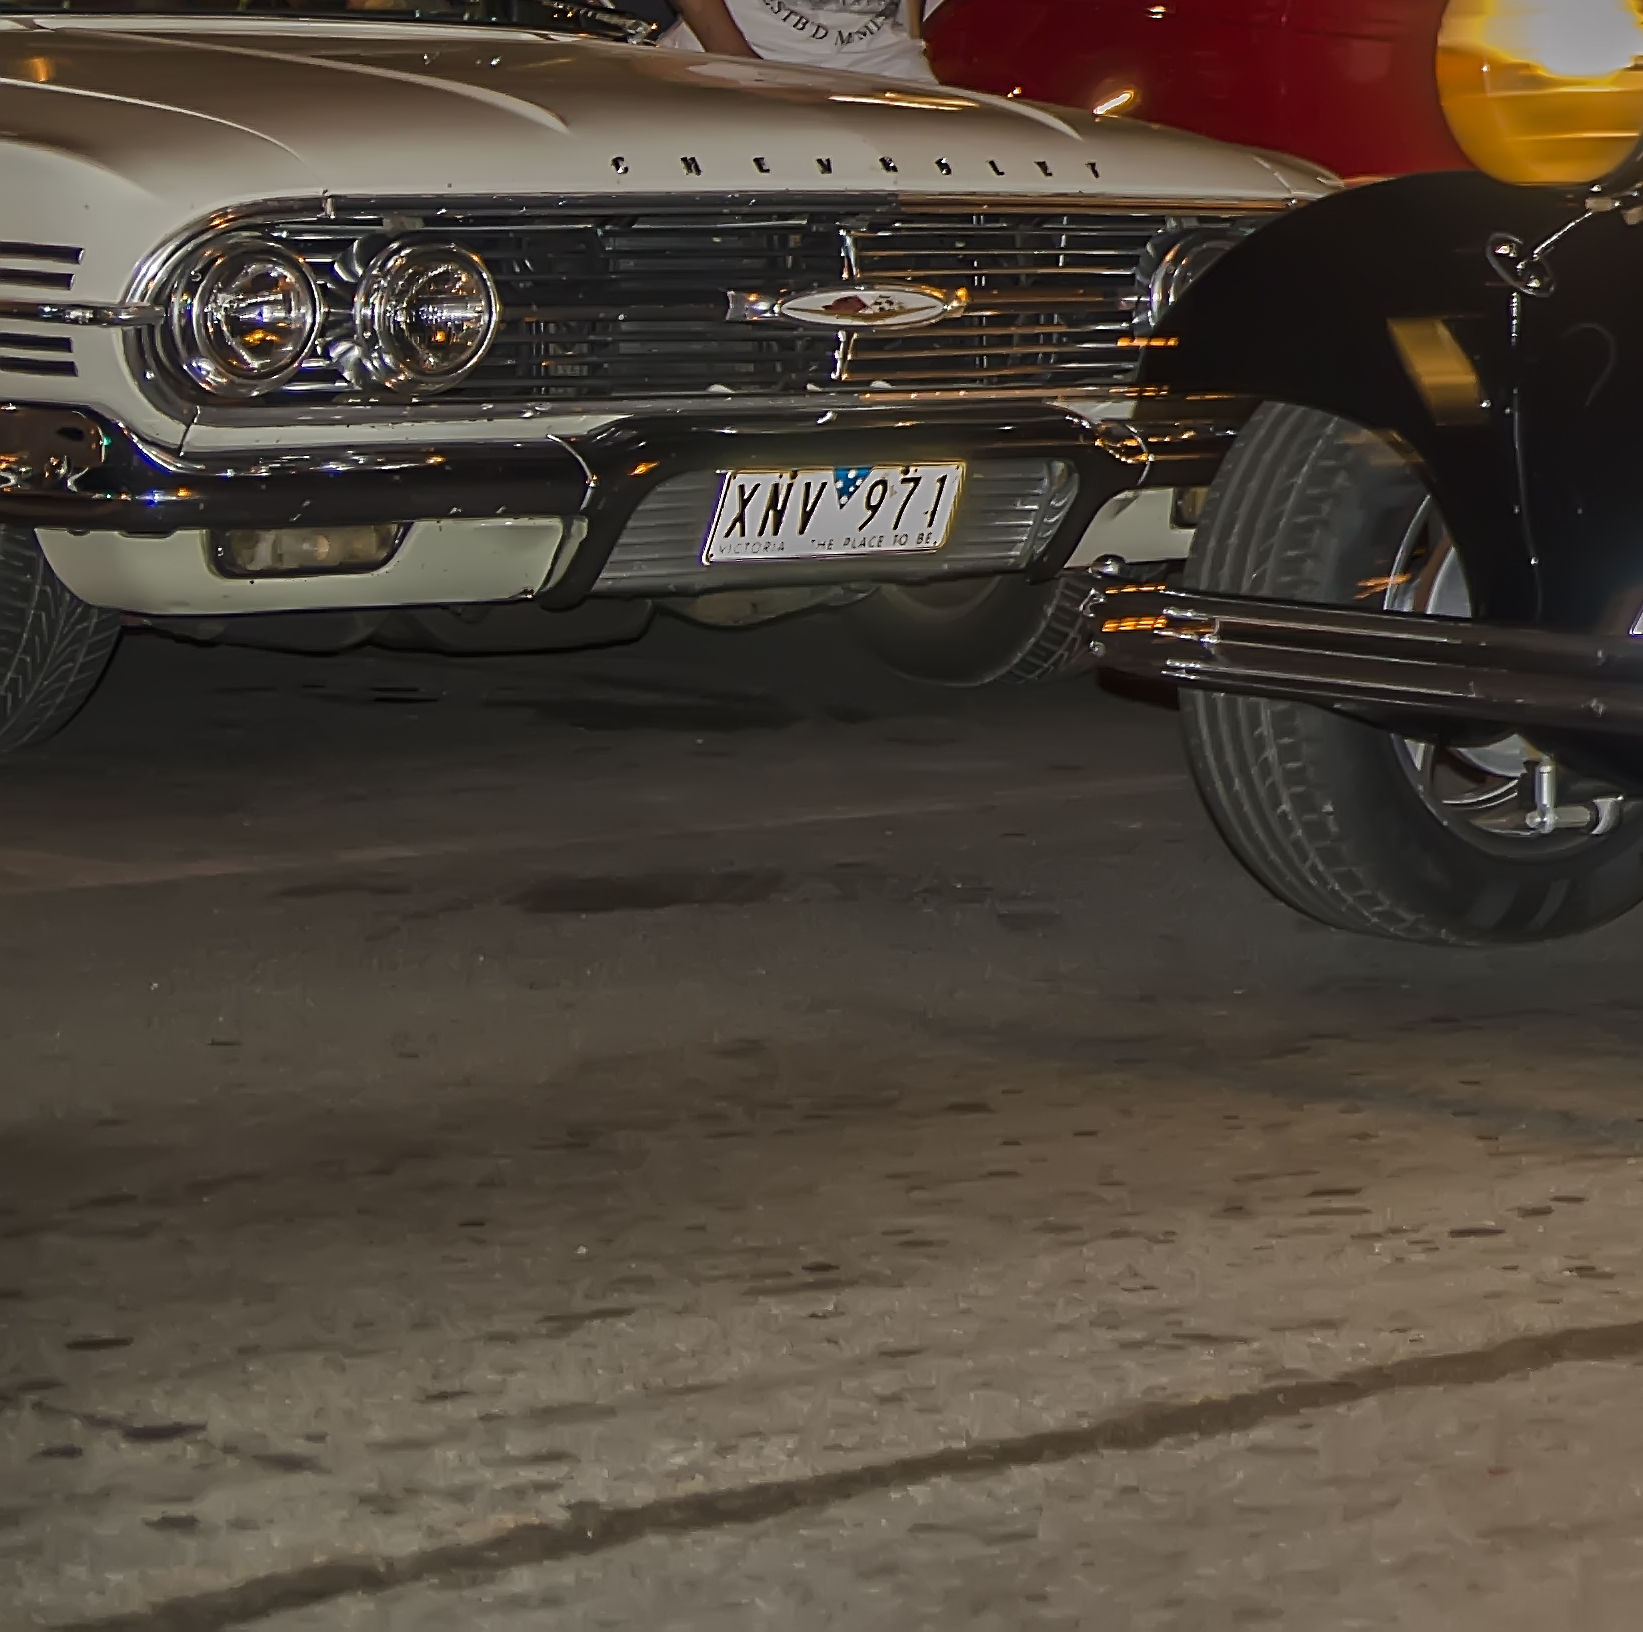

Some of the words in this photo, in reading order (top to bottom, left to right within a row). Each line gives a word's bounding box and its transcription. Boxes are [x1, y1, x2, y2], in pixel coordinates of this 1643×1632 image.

[723, 480, 828, 538] XNV
[858, 473, 948, 532] 971
[719, 540, 786, 555] VICTORIA
[842, 534, 885, 549] PLACE
[892, 532, 909, 547] TO
